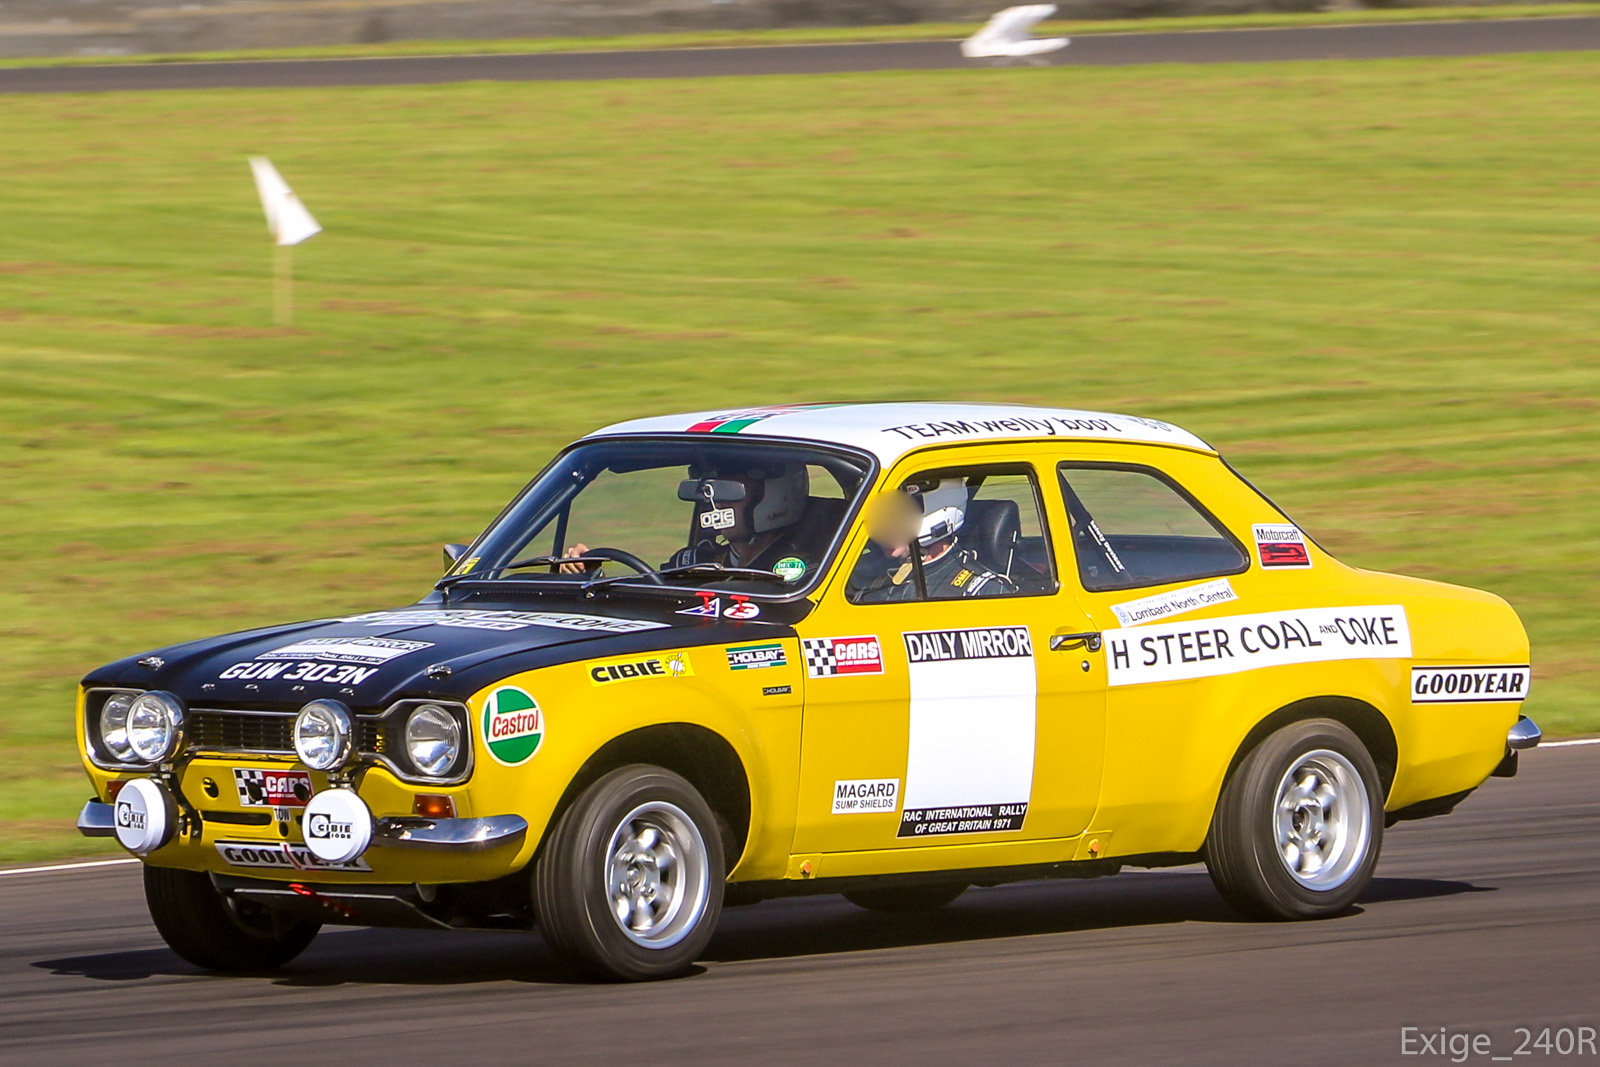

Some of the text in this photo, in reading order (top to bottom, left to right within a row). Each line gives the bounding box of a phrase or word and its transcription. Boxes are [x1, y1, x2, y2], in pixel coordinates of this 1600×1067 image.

[881, 417, 1122, 440] TEAM welly boot
[702, 510, 733, 526] OPIE
[1256, 528, 1300, 541] Motorcraft
[1127, 604, 1172, 622] Lombard
[1170, 597, 1201, 611] North
[1199, 588, 1234, 604] Central
[835, 641, 878, 661] CARS
[906, 629, 1033, 661] DAILY MIRROR
[1111, 616, 1398, 670] H STEER COAL AND COKE
[734, 650, 779, 664] HOLBAY
[219, 662, 379, 685] GUW 303N
[1415, 672, 1524, 694] GOODYEAR
[492, 709, 539, 738] Castrol
[836, 783, 895, 799] MAGARD
[835, 798, 894, 810] SUMP SHIELDS
[903, 804, 1027, 822] RAC INTERNATIONAL RALLY
[274, 808, 291, 821] TOW
[317, 823, 351, 833] CIBIE
[914, 818, 1012, 834] OF GREAT BRITAIN 1971
